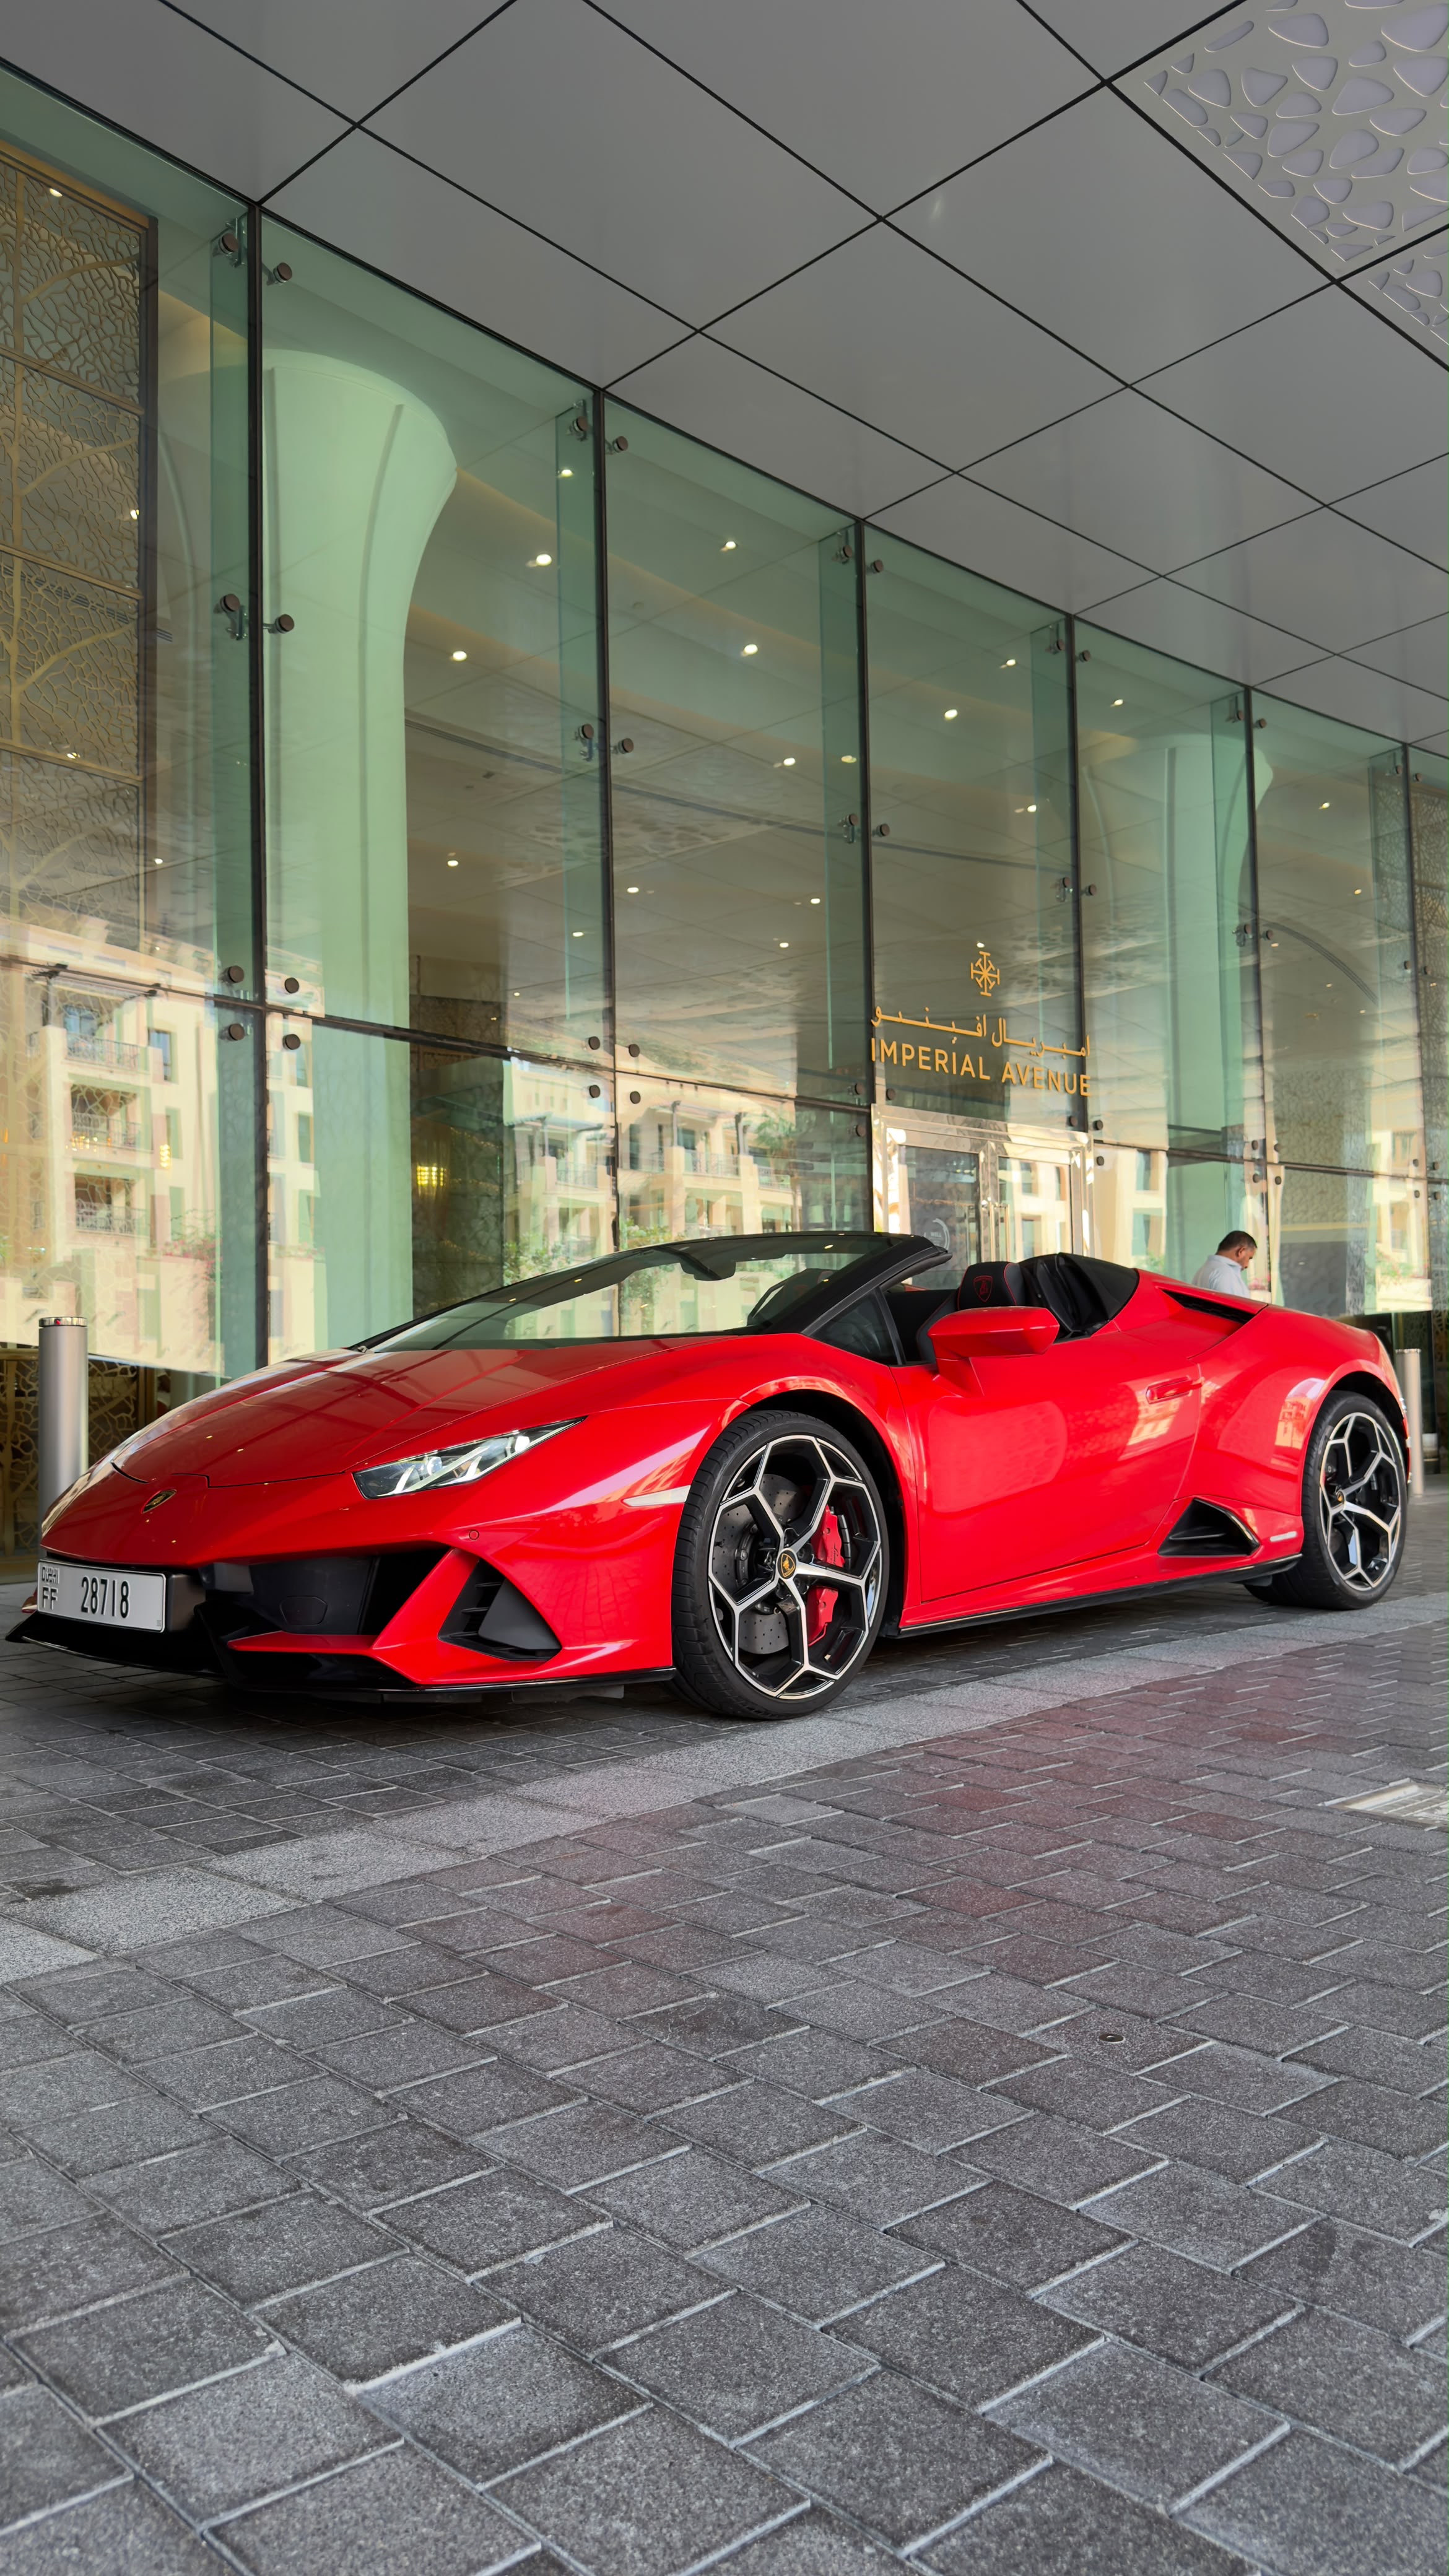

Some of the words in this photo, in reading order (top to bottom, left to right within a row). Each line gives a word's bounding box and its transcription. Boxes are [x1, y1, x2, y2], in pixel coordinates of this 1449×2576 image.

[991, 1017, 1090, 1060] امبريال
[871, 1037, 991, 1080] IMPERIAL
[1001, 1061, 1091, 1097] AVENUE
[42, 1586, 58, 1610] FF
[80, 1576, 130, 1619] 28718
